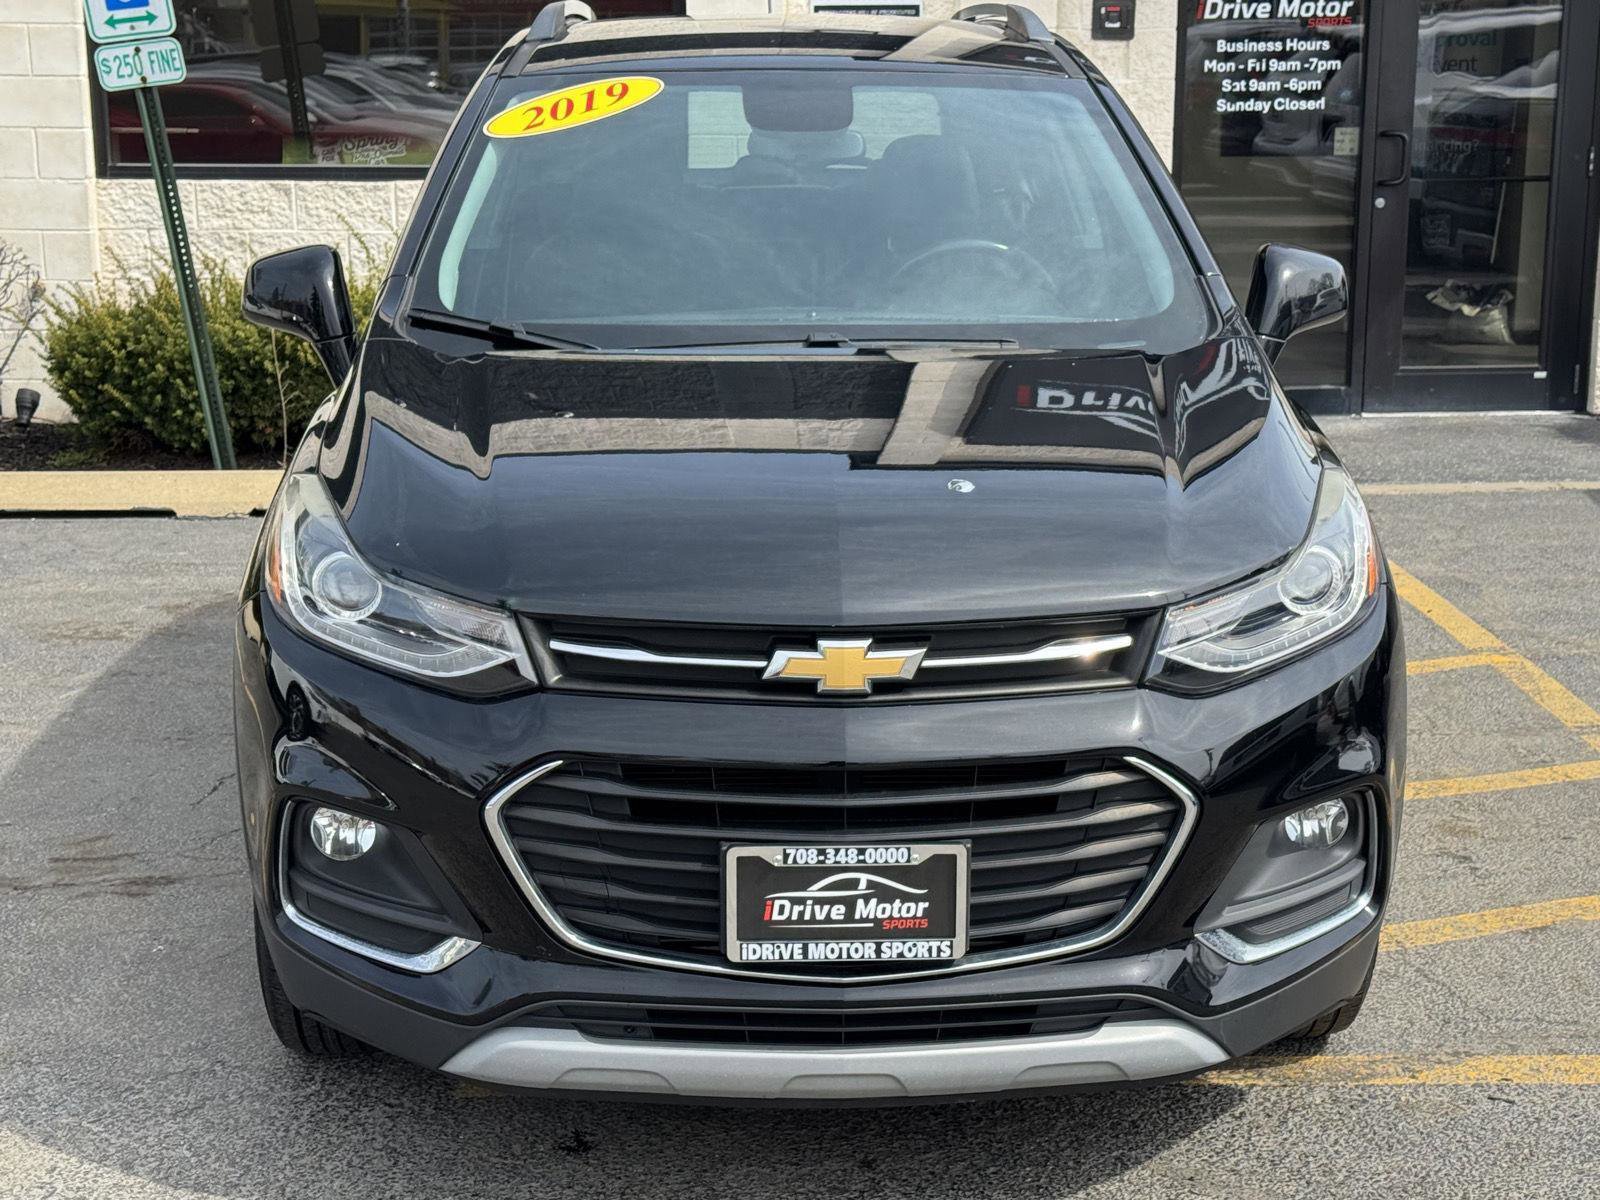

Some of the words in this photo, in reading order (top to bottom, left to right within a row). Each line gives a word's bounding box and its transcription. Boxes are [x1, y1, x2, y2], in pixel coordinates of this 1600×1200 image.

[1196, 0, 1272, 20] iDrive
[1277, 0, 1354, 18] Motor
[1308, 17, 1353, 29] SPORTS
[1216, 38, 1283, 53] Business
[1286, 38, 1331, 52] Hours
[101, 53, 143, 79] $250
[147, 48, 181, 75] FINE
[1203, 59, 1235, 73] Mon
[1269, 58, 1301, 72] 9am
[1221, 78, 1247, 92] Sat
[1249, 78, 1281, 92] 9am
[522, 82, 629, 131] 2019
[1216, 98, 1272, 114] Sunday
[1273, 97, 1326, 111] Closed
[785, 847, 909, 865] 708-348-0000
[763, 898, 846, 921] iDrive
[854, 898, 930, 920] Motor
[881, 918, 929, 930] SPORTS
[807, 942, 877, 960] MOTOR
[880, 940, 952, 959] SPORTS
